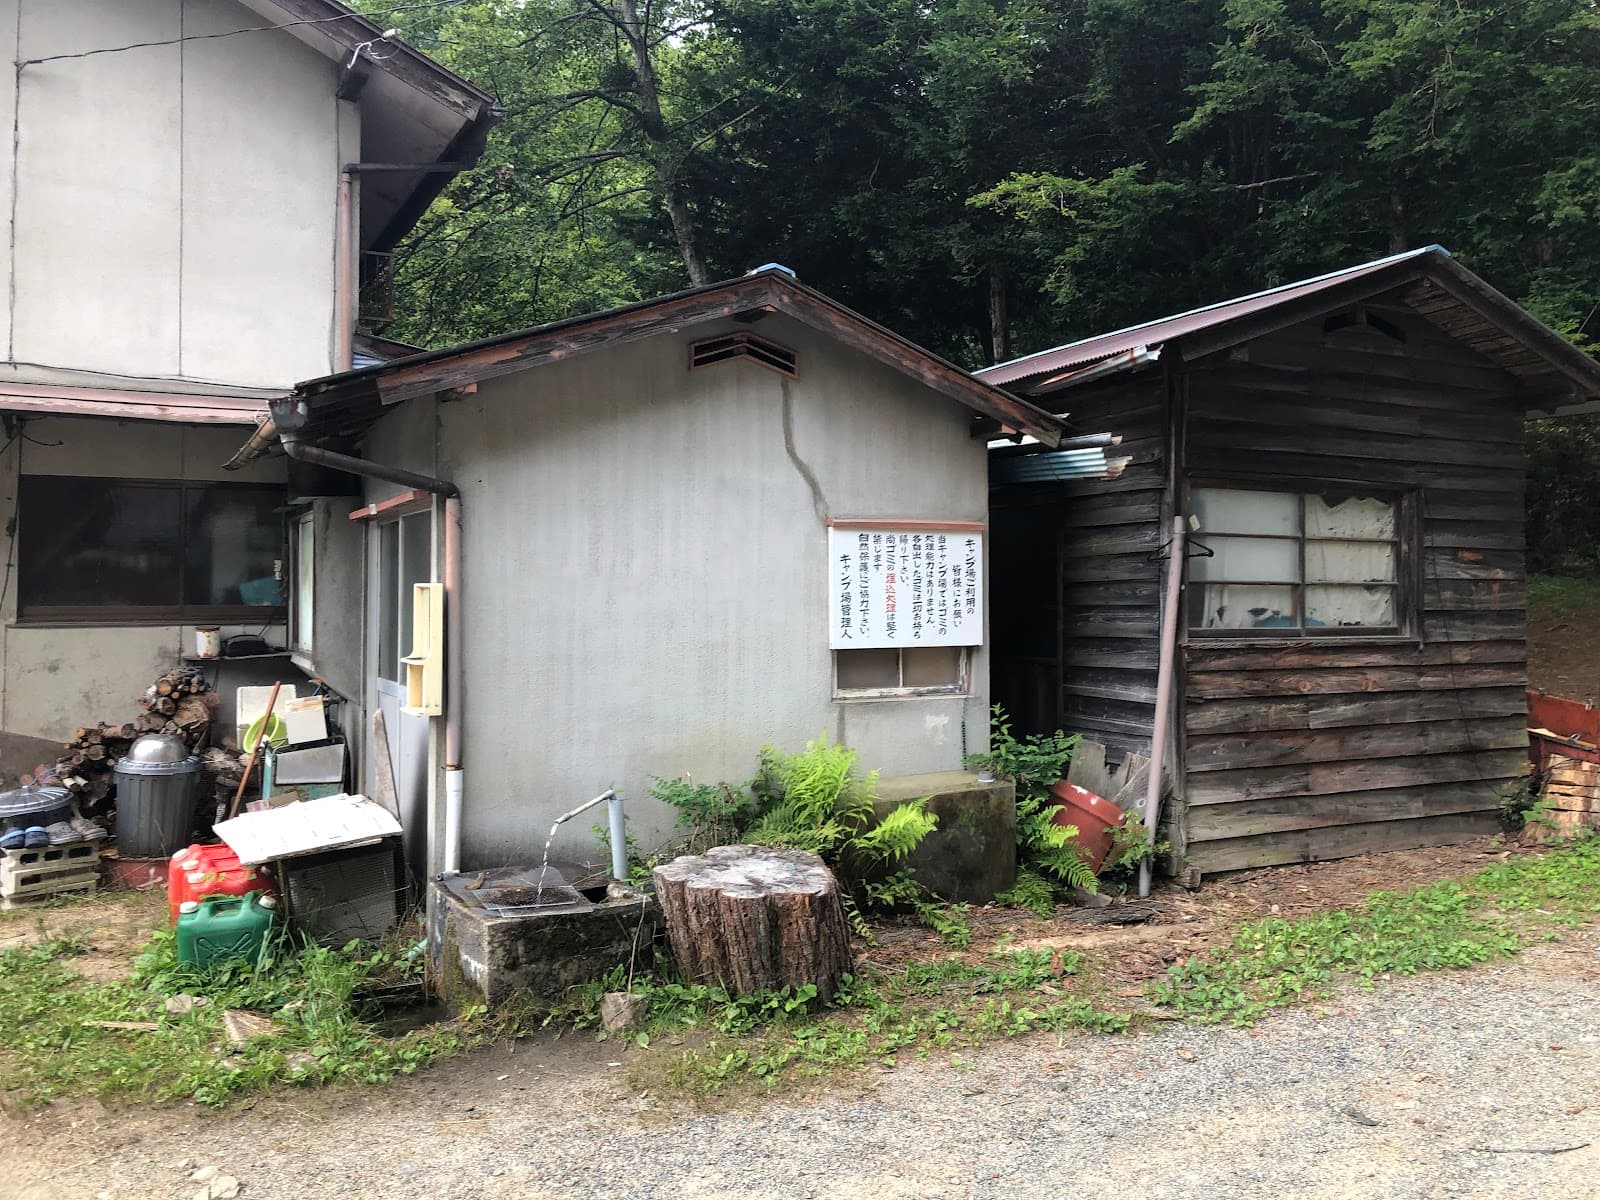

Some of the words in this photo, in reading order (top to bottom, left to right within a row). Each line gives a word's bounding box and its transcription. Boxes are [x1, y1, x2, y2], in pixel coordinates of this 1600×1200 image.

[840, 553, 852, 639] キャンプ場管理人
[924, 535, 936, 629] 処理能力はありません。
[937, 535, 948, 636] 当キャンプ場ではゴミの
[952, 564, 963, 628] 皆様にお願い
[965, 539, 977, 615] キャンプ場ご利用の
